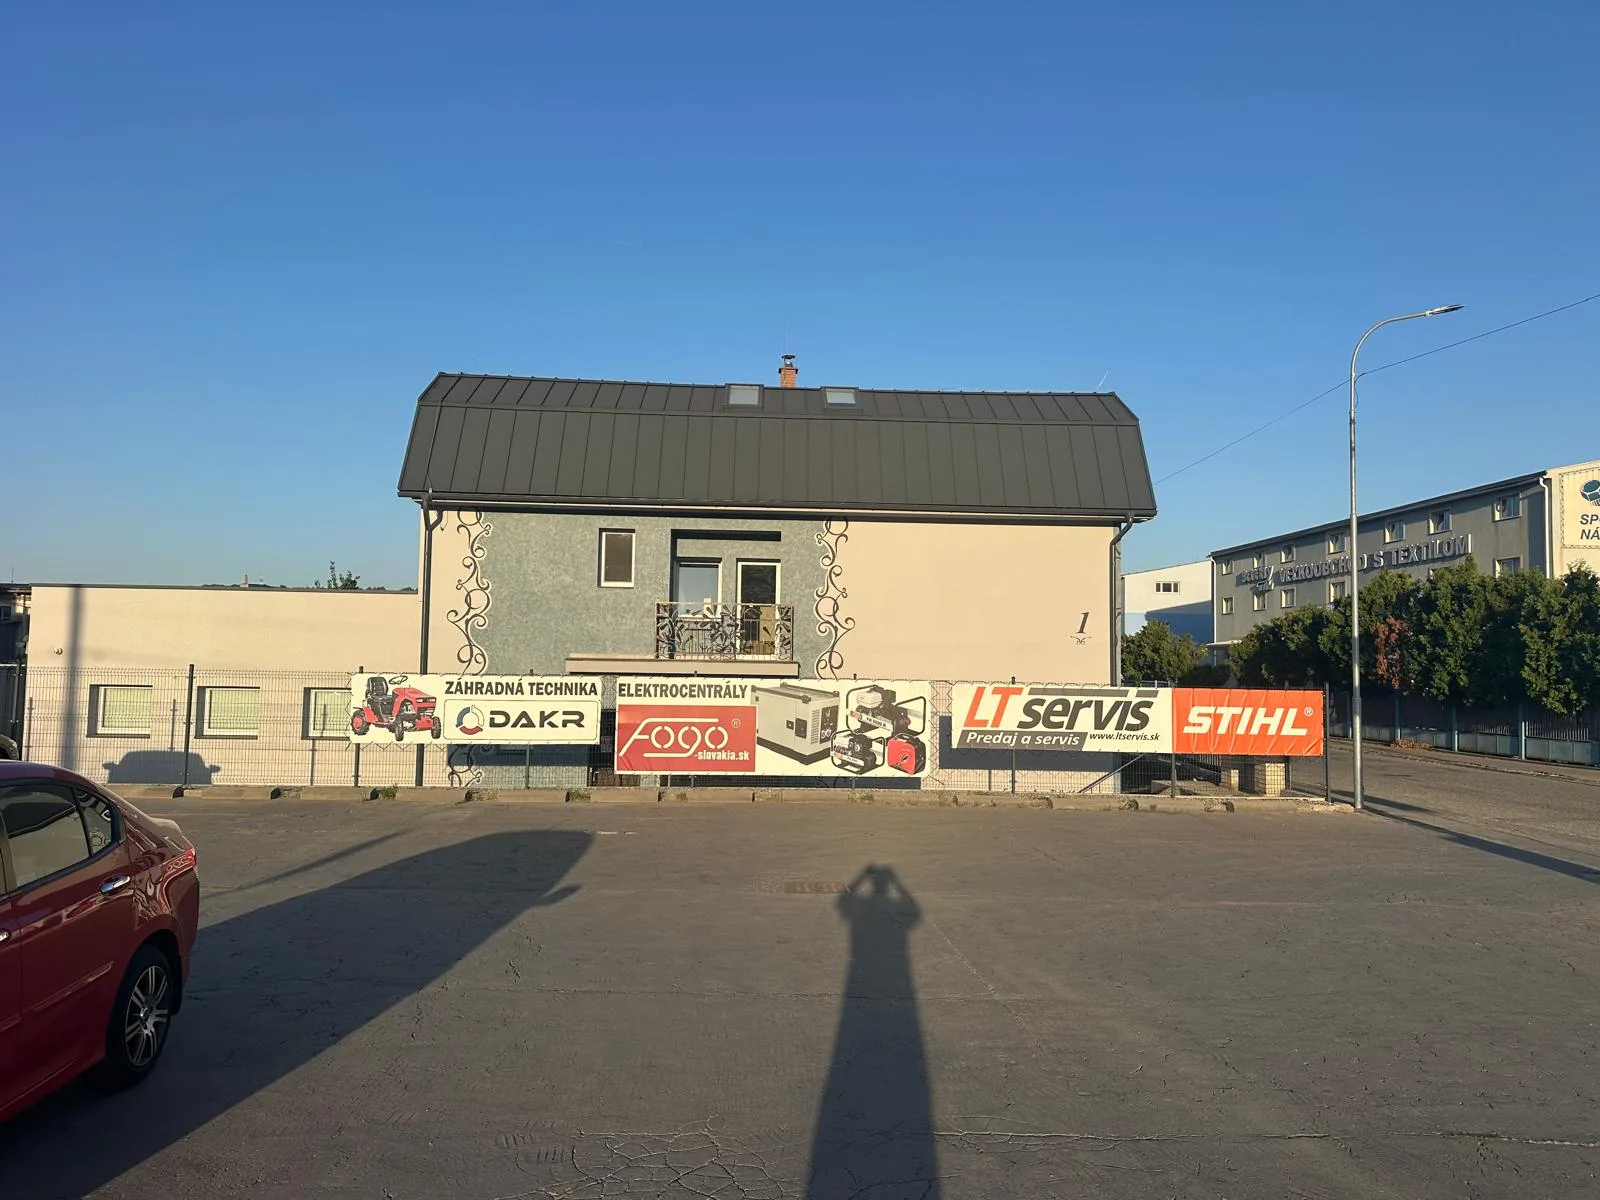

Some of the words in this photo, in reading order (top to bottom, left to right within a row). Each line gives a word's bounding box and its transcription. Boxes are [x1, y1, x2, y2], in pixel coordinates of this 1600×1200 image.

[1580, 514, 1600, 525] SP
[1373, 550, 1384, 568] S
[1391, 533, 1472, 566] TEXTILOM
[1076, 612, 1089, 634] 1
[445, 679, 524, 696] ZÁHRADNÁ
[529, 682, 598, 696] TECHNIKA
[618, 680, 748, 699] ELEKTROCENTRÁLY
[963, 686, 1023, 728] LT
[1017, 690, 1157, 731] servis
[489, 710, 585, 728] DAKR
[1183, 706, 1308, 736] STIHL
[966, 732, 1016, 746] Predaj
[1021, 736, 1031, 745] a
[1037, 734, 1080, 746] servis
[1089, 732, 1160, 741] www.ltservis.sk
